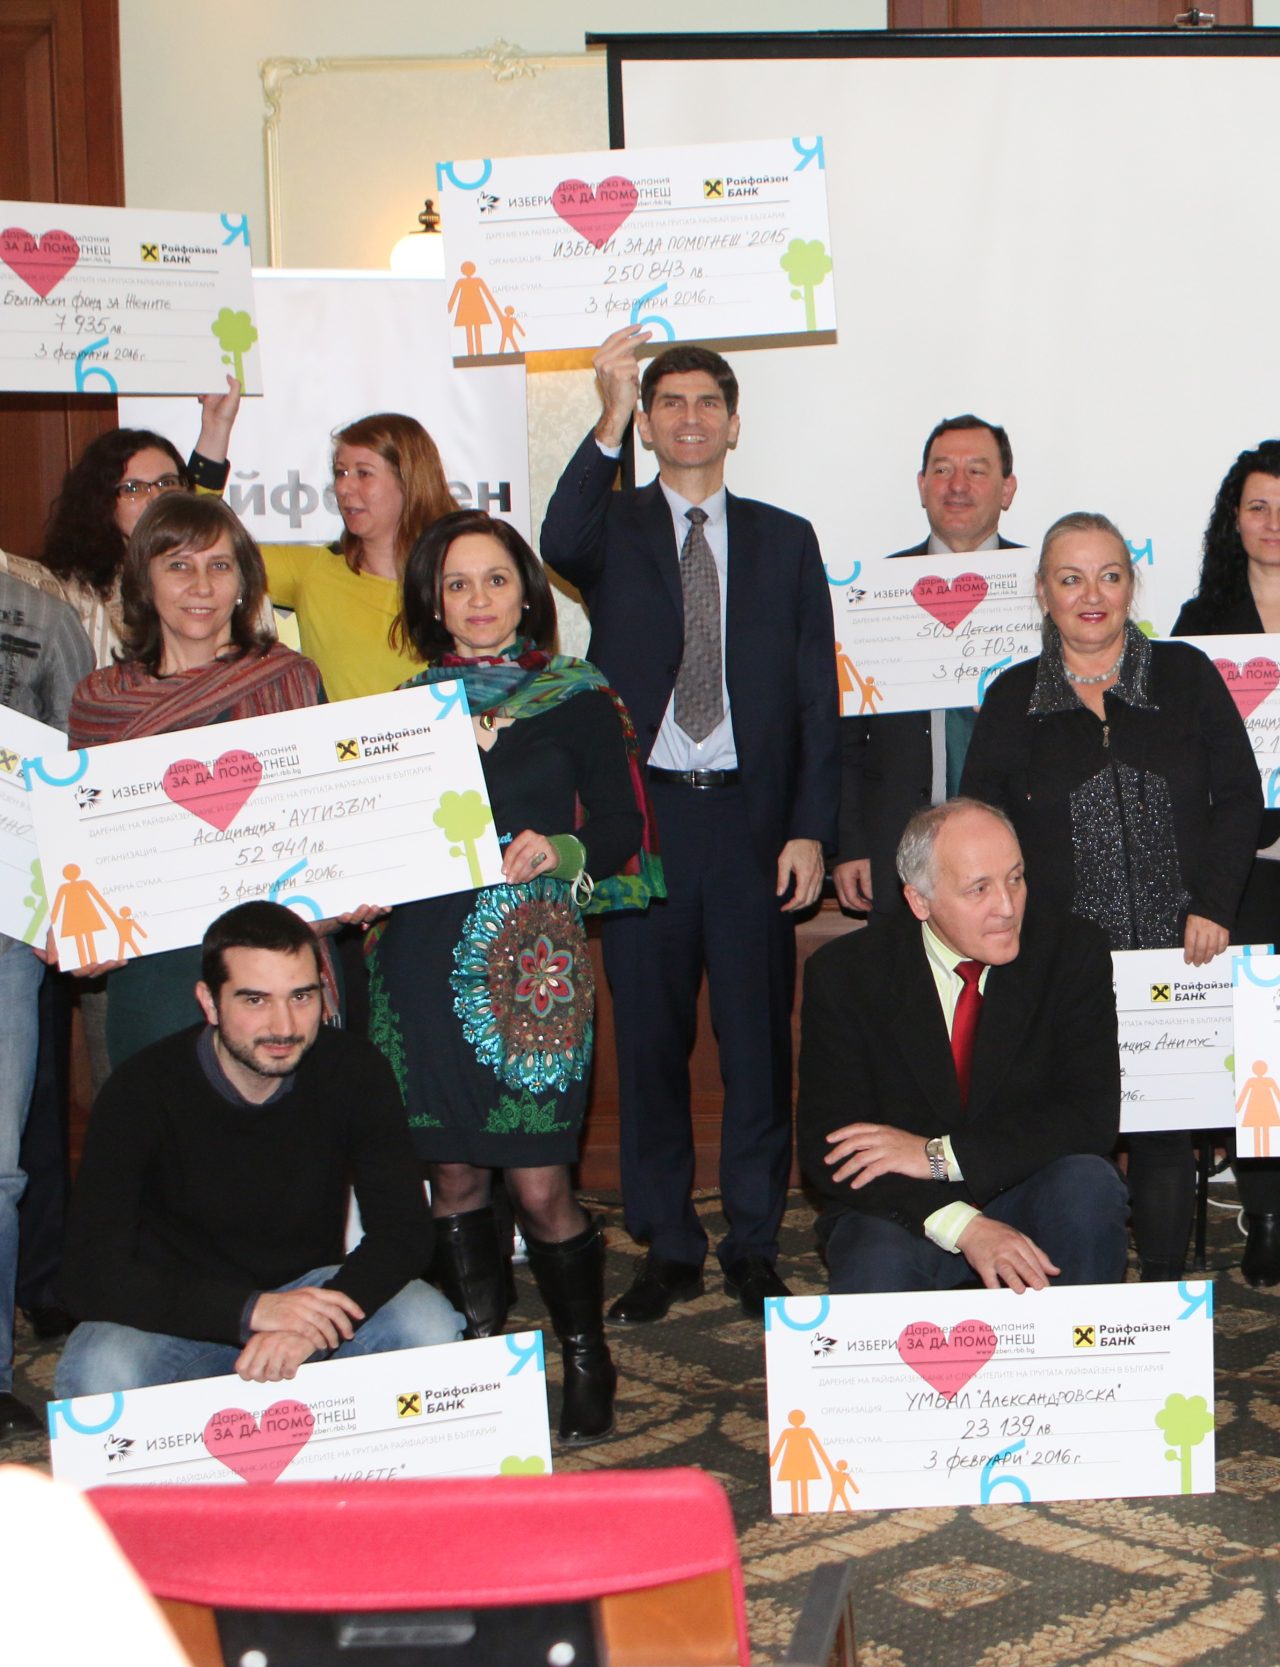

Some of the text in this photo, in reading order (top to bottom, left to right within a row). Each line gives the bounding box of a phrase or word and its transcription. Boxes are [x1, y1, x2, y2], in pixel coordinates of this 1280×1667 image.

[726, 173, 788, 187] Райфайзен
[560, 194, 575, 204] ЗА
[580, 192, 596, 204] ДА
[601, 186, 671, 201] ПОМОГНЕШ
[727, 186, 759, 197] БАНК
[163, 255, 191, 264] БАНК
[603, 260, 685, 285] 250 843
[585, 300, 597, 314] 3
[918, 587, 932, 595] ЗА
[936, 585, 950, 595] ДА
[954, 580, 1019, 592] ПОМОГНЕШ
[1227, 670, 1242, 681] ДА
[360, 723, 431, 746] Райфайзен
[363, 741, 400, 757] БАНК
[171, 775, 190, 788] ЗА
[194, 770, 214, 785] ДА
[218, 754, 300, 779] ПОМОГНЕШ
[235, 846, 264, 866] 52
[218, 886, 230, 901] 3
[1174, 992, 1207, 1001] БАНК
[978, 1322, 1034, 1332] кампания
[1099, 1322, 1170, 1335] Райфайзен
[906, 1338, 924, 1349] ЗА
[929, 1337, 948, 1350] ДА
[954, 1333, 1035, 1347] ПОМОГНЕШ
[1099, 1336, 1136, 1347] БАНК
[425, 1382, 501, 1400] Райфайзен
[427, 1399, 465, 1414] БАНК
[214, 1426, 234, 1441] ЗА
[239, 1424, 261, 1439] ДА
[267, 1408, 356, 1433] ПОМОГНЕШ
[961, 1415, 1034, 1439] 23 139
[924, 1451, 937, 1469] 3
